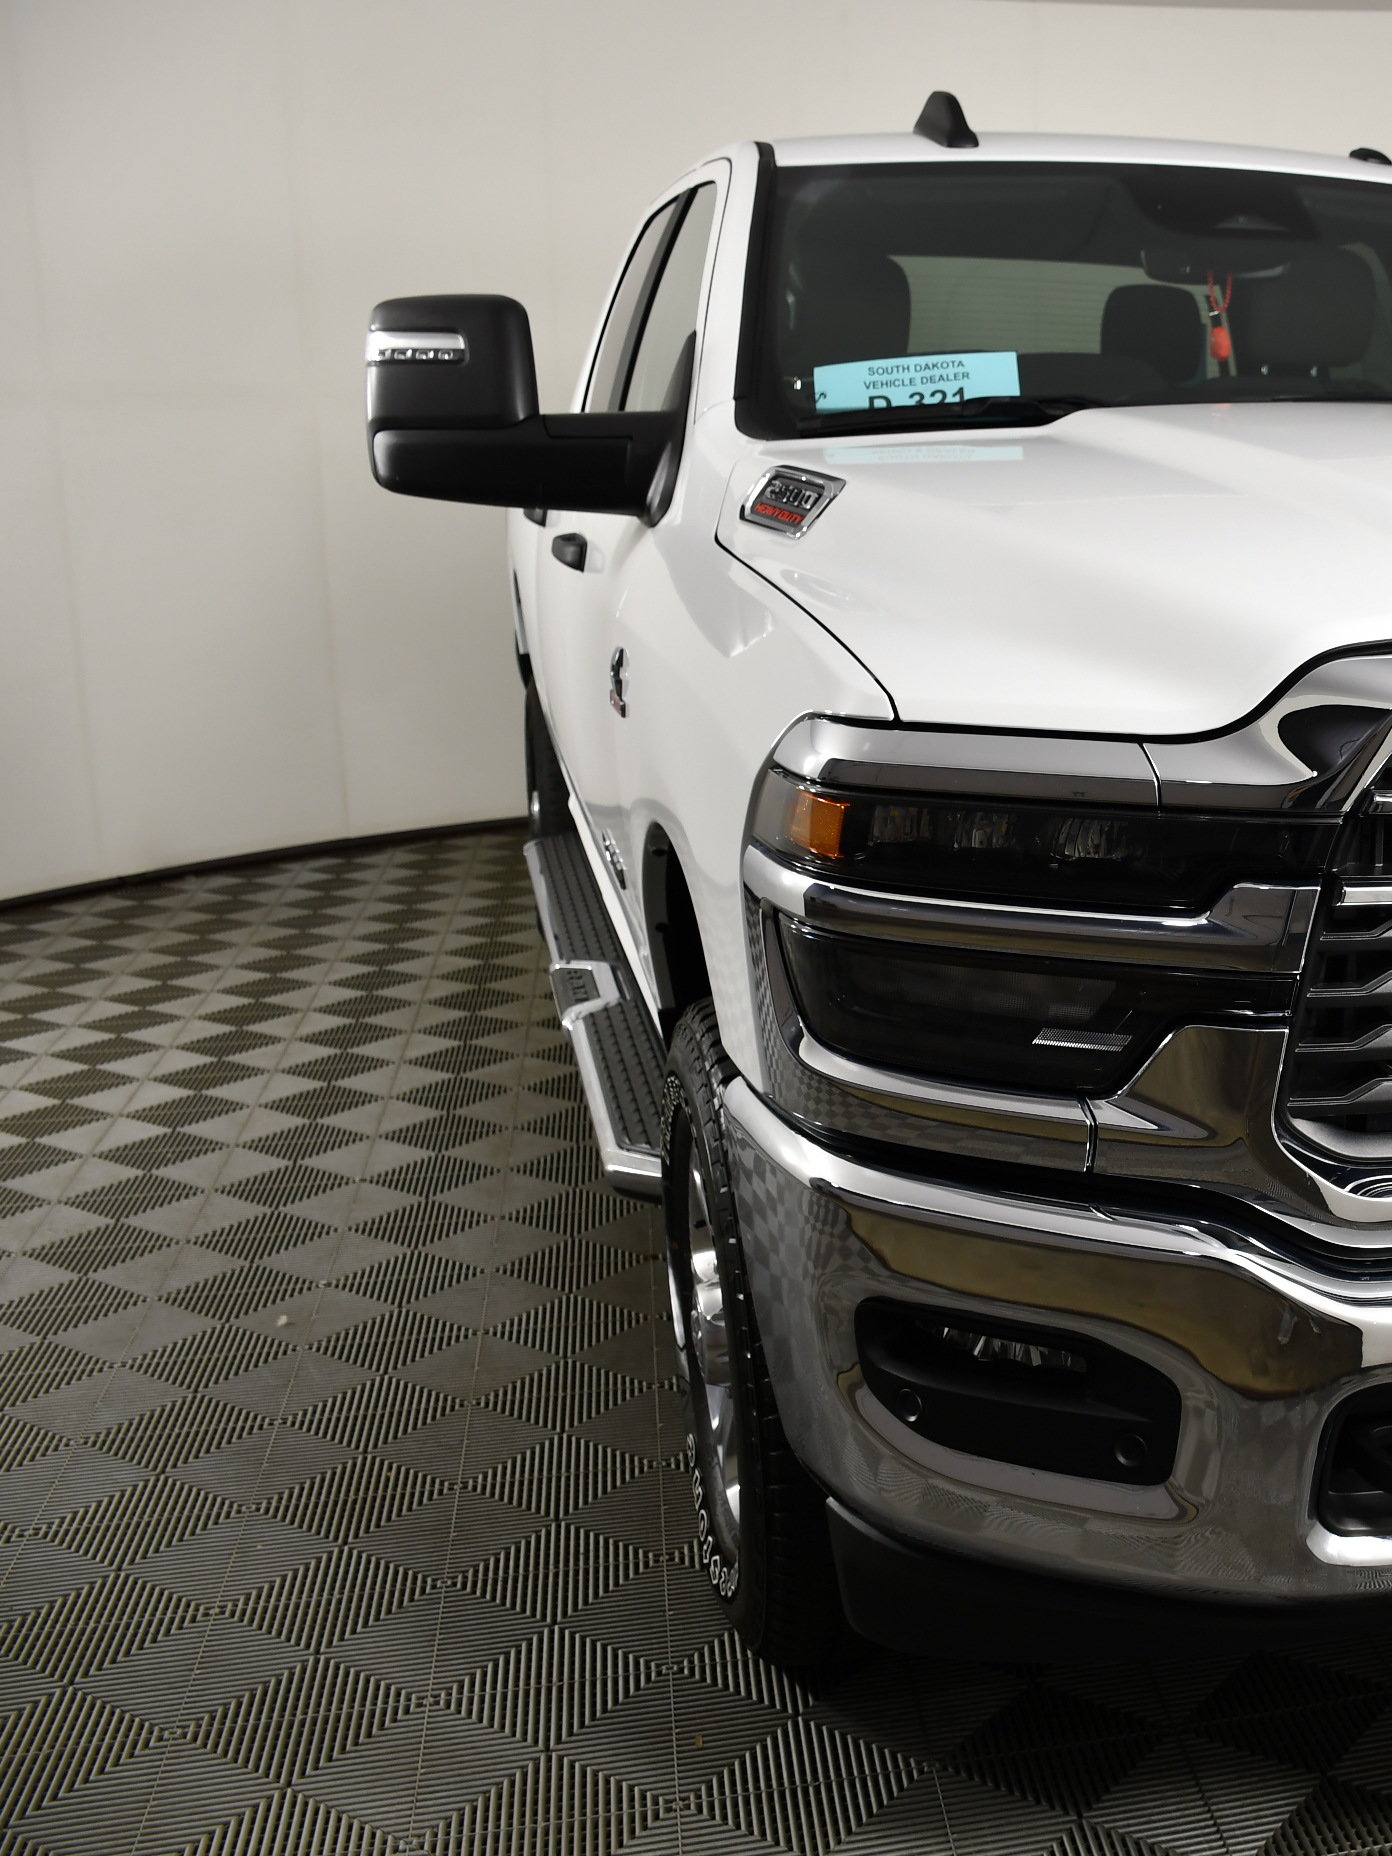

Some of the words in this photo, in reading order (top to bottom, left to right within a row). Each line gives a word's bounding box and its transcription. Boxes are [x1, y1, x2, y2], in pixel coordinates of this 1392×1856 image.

[868, 365, 910, 376] SOUTH
[914, 360, 966, 373] DAKOTA
[863, 377, 917, 390] VEHICLE
[920, 371, 970, 385] DEALER
